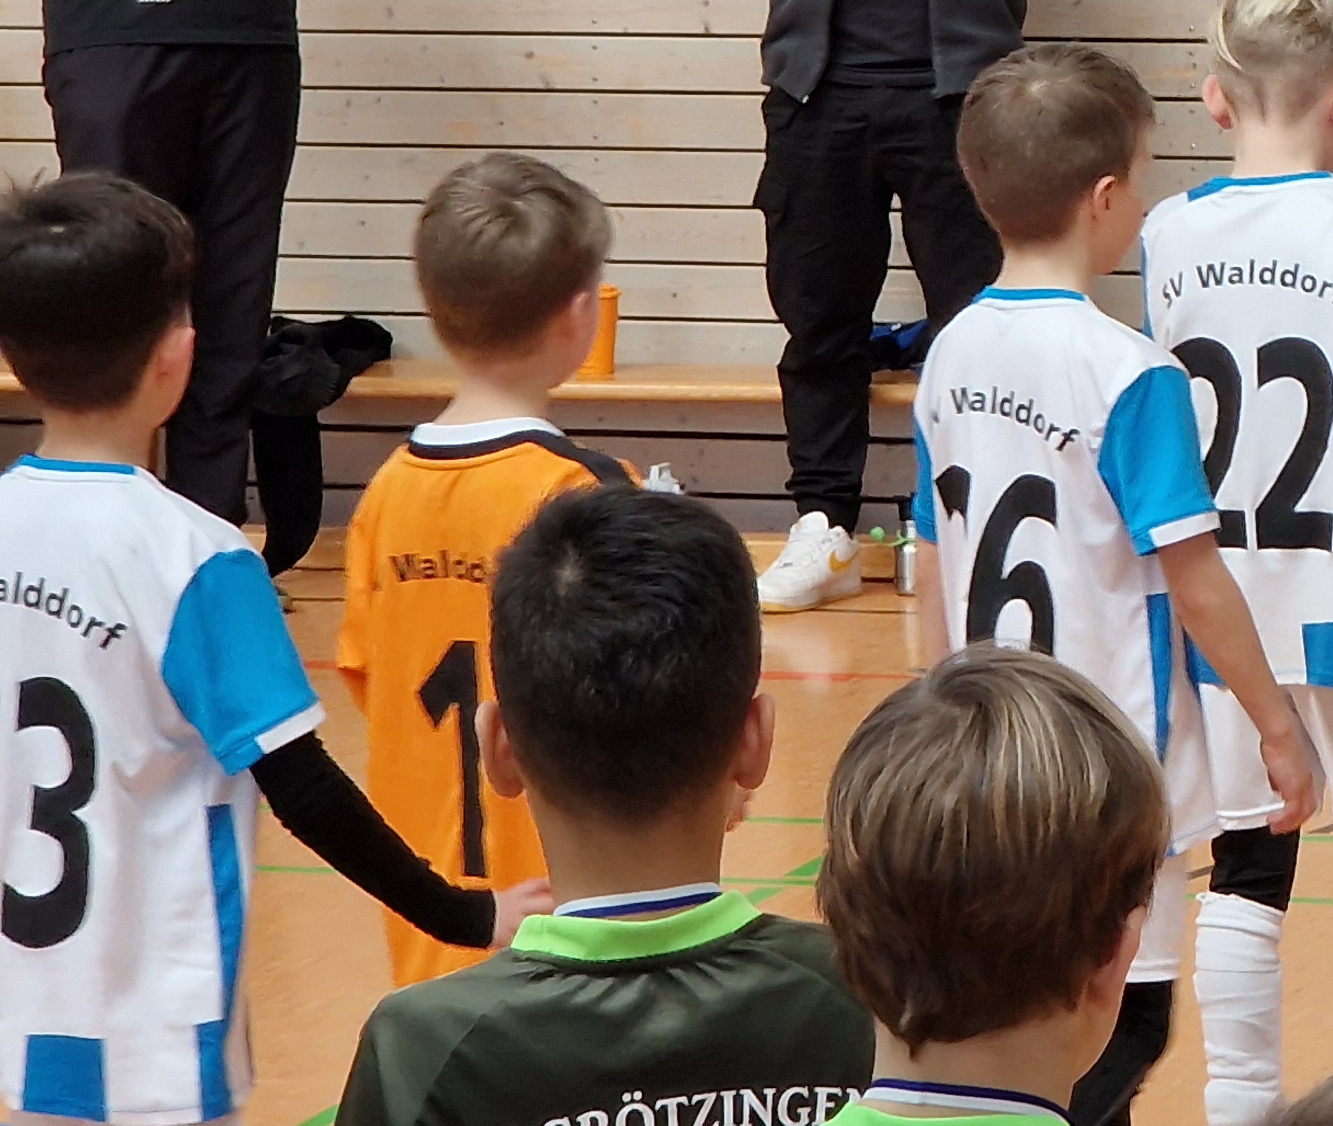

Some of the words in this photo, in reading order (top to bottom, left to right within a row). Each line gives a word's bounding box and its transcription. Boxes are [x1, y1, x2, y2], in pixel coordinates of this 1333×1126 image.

[1162, 272, 1184, 309] SV
[950, 385, 1080, 452] Walddorf
[388, 549, 488, 584] Waldd
[0, 571, 128, 651] alddorf
[0, 676, 96, 949] 3
[543, 1086, 870, 1126] ÖTZINGE
